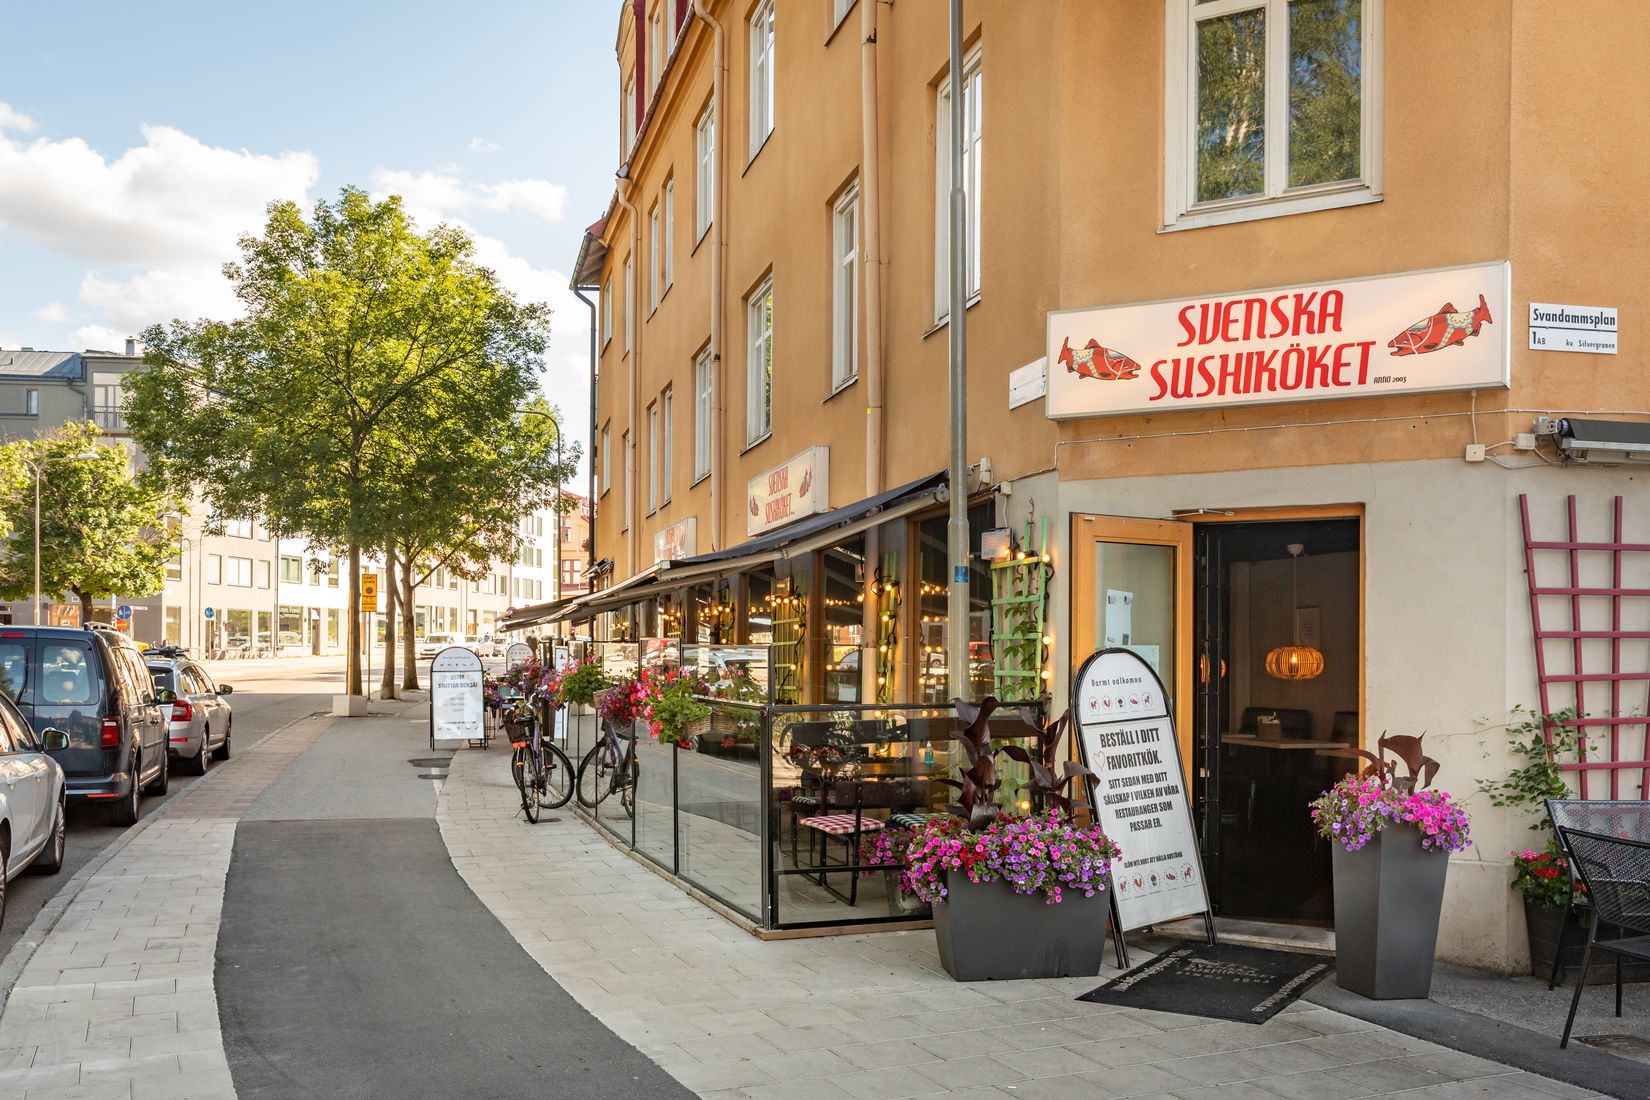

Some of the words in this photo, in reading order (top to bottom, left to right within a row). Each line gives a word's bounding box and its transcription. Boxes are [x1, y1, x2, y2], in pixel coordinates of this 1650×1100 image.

[1177, 289, 1344, 347] SVENSKA
[1533, 308, 1616, 328] Svandammsplan
[1149, 341, 1376, 401] SUSHIKÖKET
[1373, 375, 1391, 384] ANNO
[1100, 729, 1135, 748] BESTÄLL
[1135, 730, 1140, 744] I
[1140, 727, 1160, 743] DITT
[1106, 748, 1162, 770] FAVORITKÖK.
[1108, 778, 1121, 790] SITT
[1121, 775, 1141, 788] SEDAN
[1140, 773, 1155, 785] MED
[1154, 771, 1168, 783] DITT
[1103, 792, 1130, 806] SÄLLSKAP
[1130, 791, 1134, 801] I
[1134, 788, 1155, 801] VILKEN
[1155, 786, 1164, 798] AV
[1163, 783, 1180, 796] VÅRA
[1114, 802, 1159, 819] RESTAURANGER
[1158, 800, 1173, 812] SOM
[1129, 819, 1153, 832] PASSAR
[1153, 817, 1163, 828] ER.
